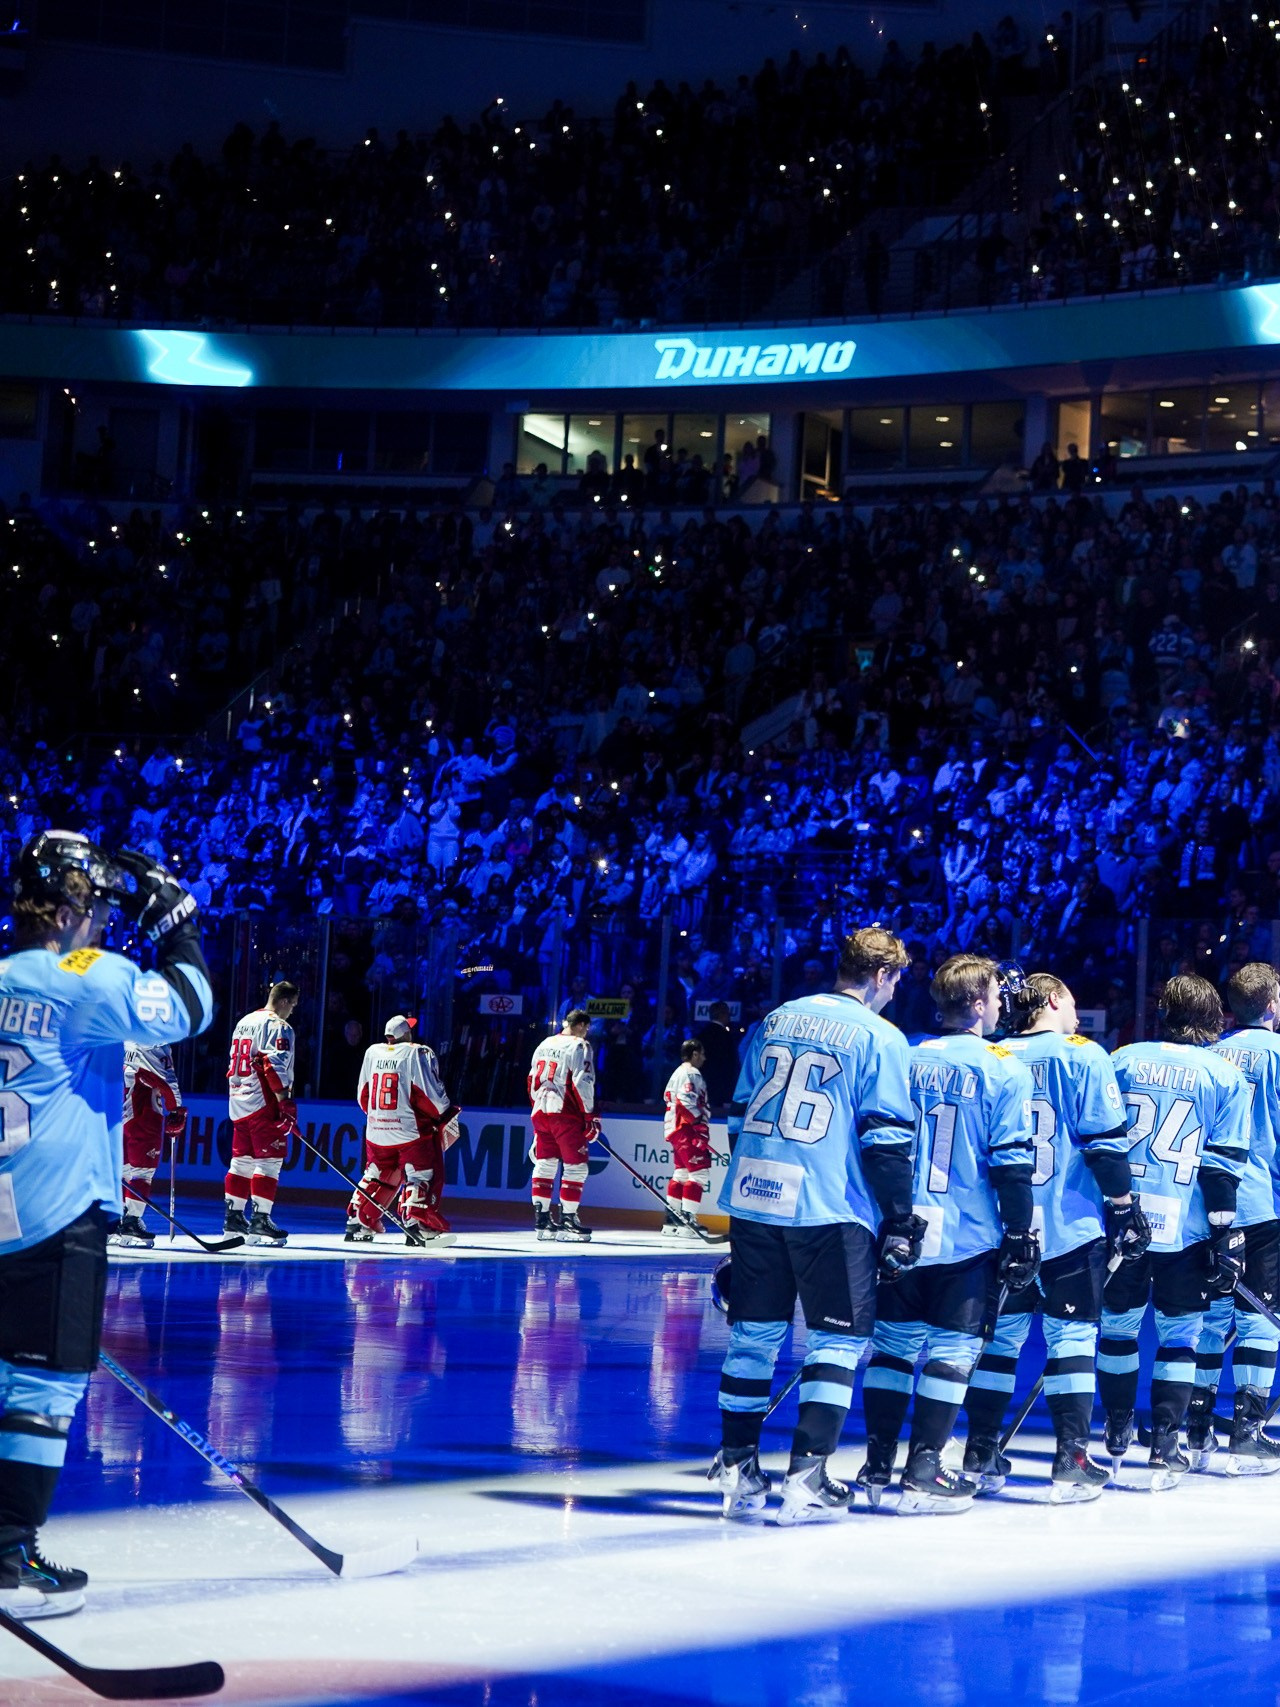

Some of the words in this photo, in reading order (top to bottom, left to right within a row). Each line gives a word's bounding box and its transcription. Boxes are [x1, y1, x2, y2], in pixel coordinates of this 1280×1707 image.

[0, 997, 55, 1038] BEL
[370, 1072, 400, 1111] 18
[742, 1043, 843, 1145] 26
[910, 1063, 979, 1100] KAYLO
[1135, 1061, 1199, 1092] SMITH
[1122, 1091, 1203, 1186] 24
